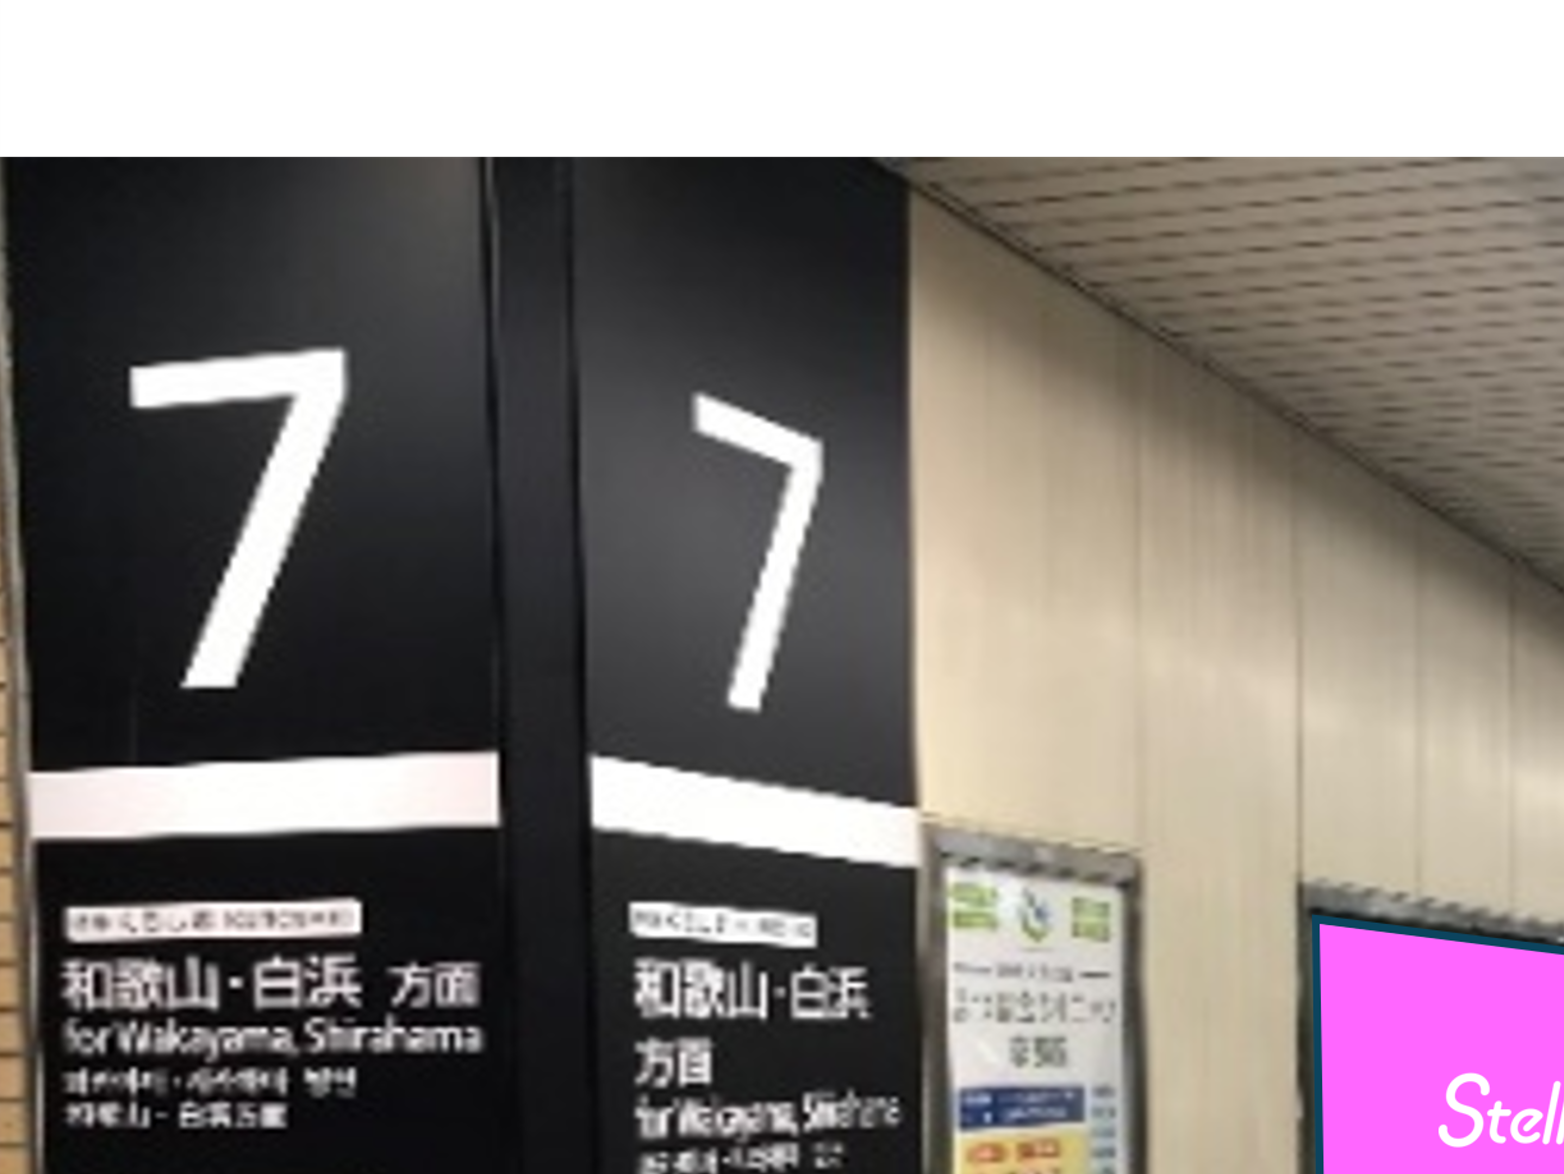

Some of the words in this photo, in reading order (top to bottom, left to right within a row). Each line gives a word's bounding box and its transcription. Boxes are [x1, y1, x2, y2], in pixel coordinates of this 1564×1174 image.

[130, 349, 346, 689] 7
[693, 393, 824, 711] 7
[389, 963, 481, 1008] 方面
[634, 1037, 714, 1088] 方面
